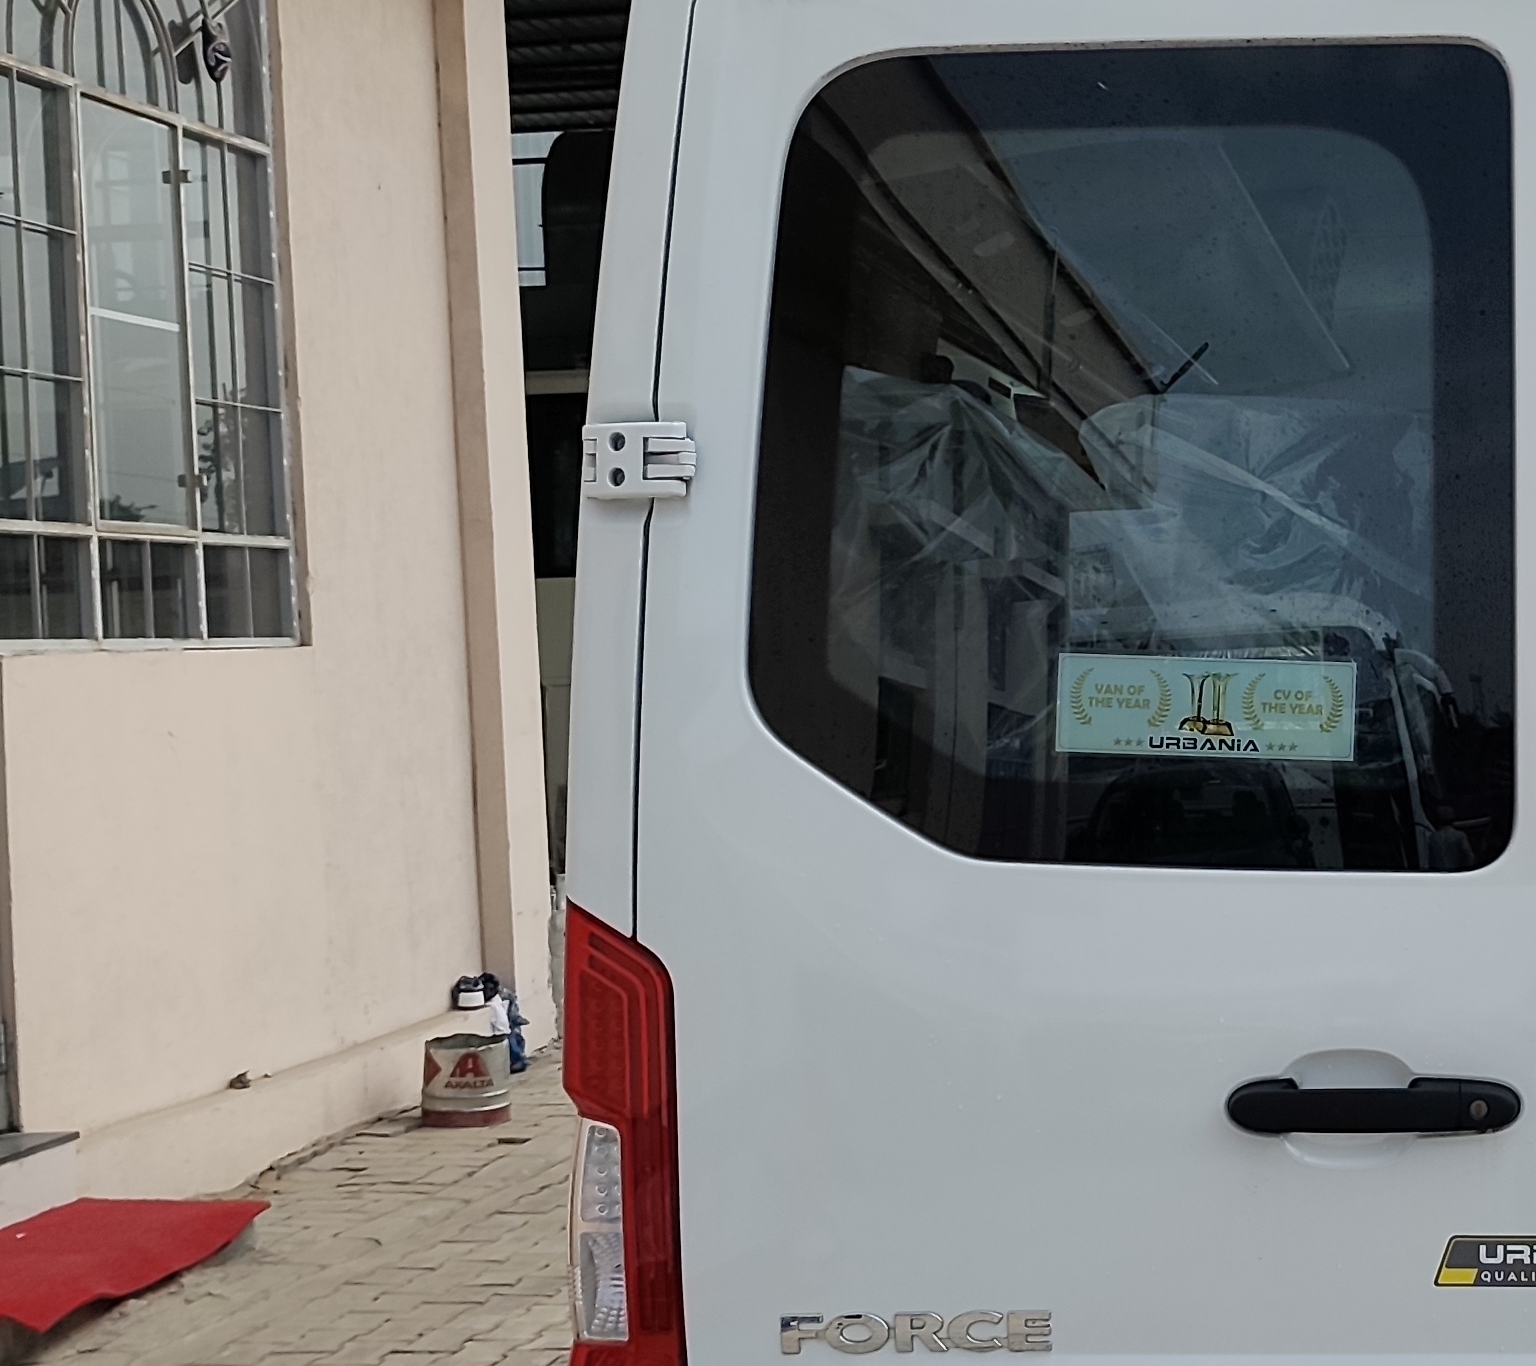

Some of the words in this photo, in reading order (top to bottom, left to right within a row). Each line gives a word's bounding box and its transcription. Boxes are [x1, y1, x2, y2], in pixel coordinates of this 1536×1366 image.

[1095, 684, 1124, 696] VAN
[1128, 685, 1146, 696] OF
[1273, 690, 1292, 701] CV
[1295, 690, 1313, 702] OF
[1088, 696, 1113, 709] THE
[1116, 697, 1151, 710] YEAR
[1260, 703, 1286, 714] THE
[1289, 704, 1323, 716] YEAR
[779, 1309, 1053, 1355] FORCE
